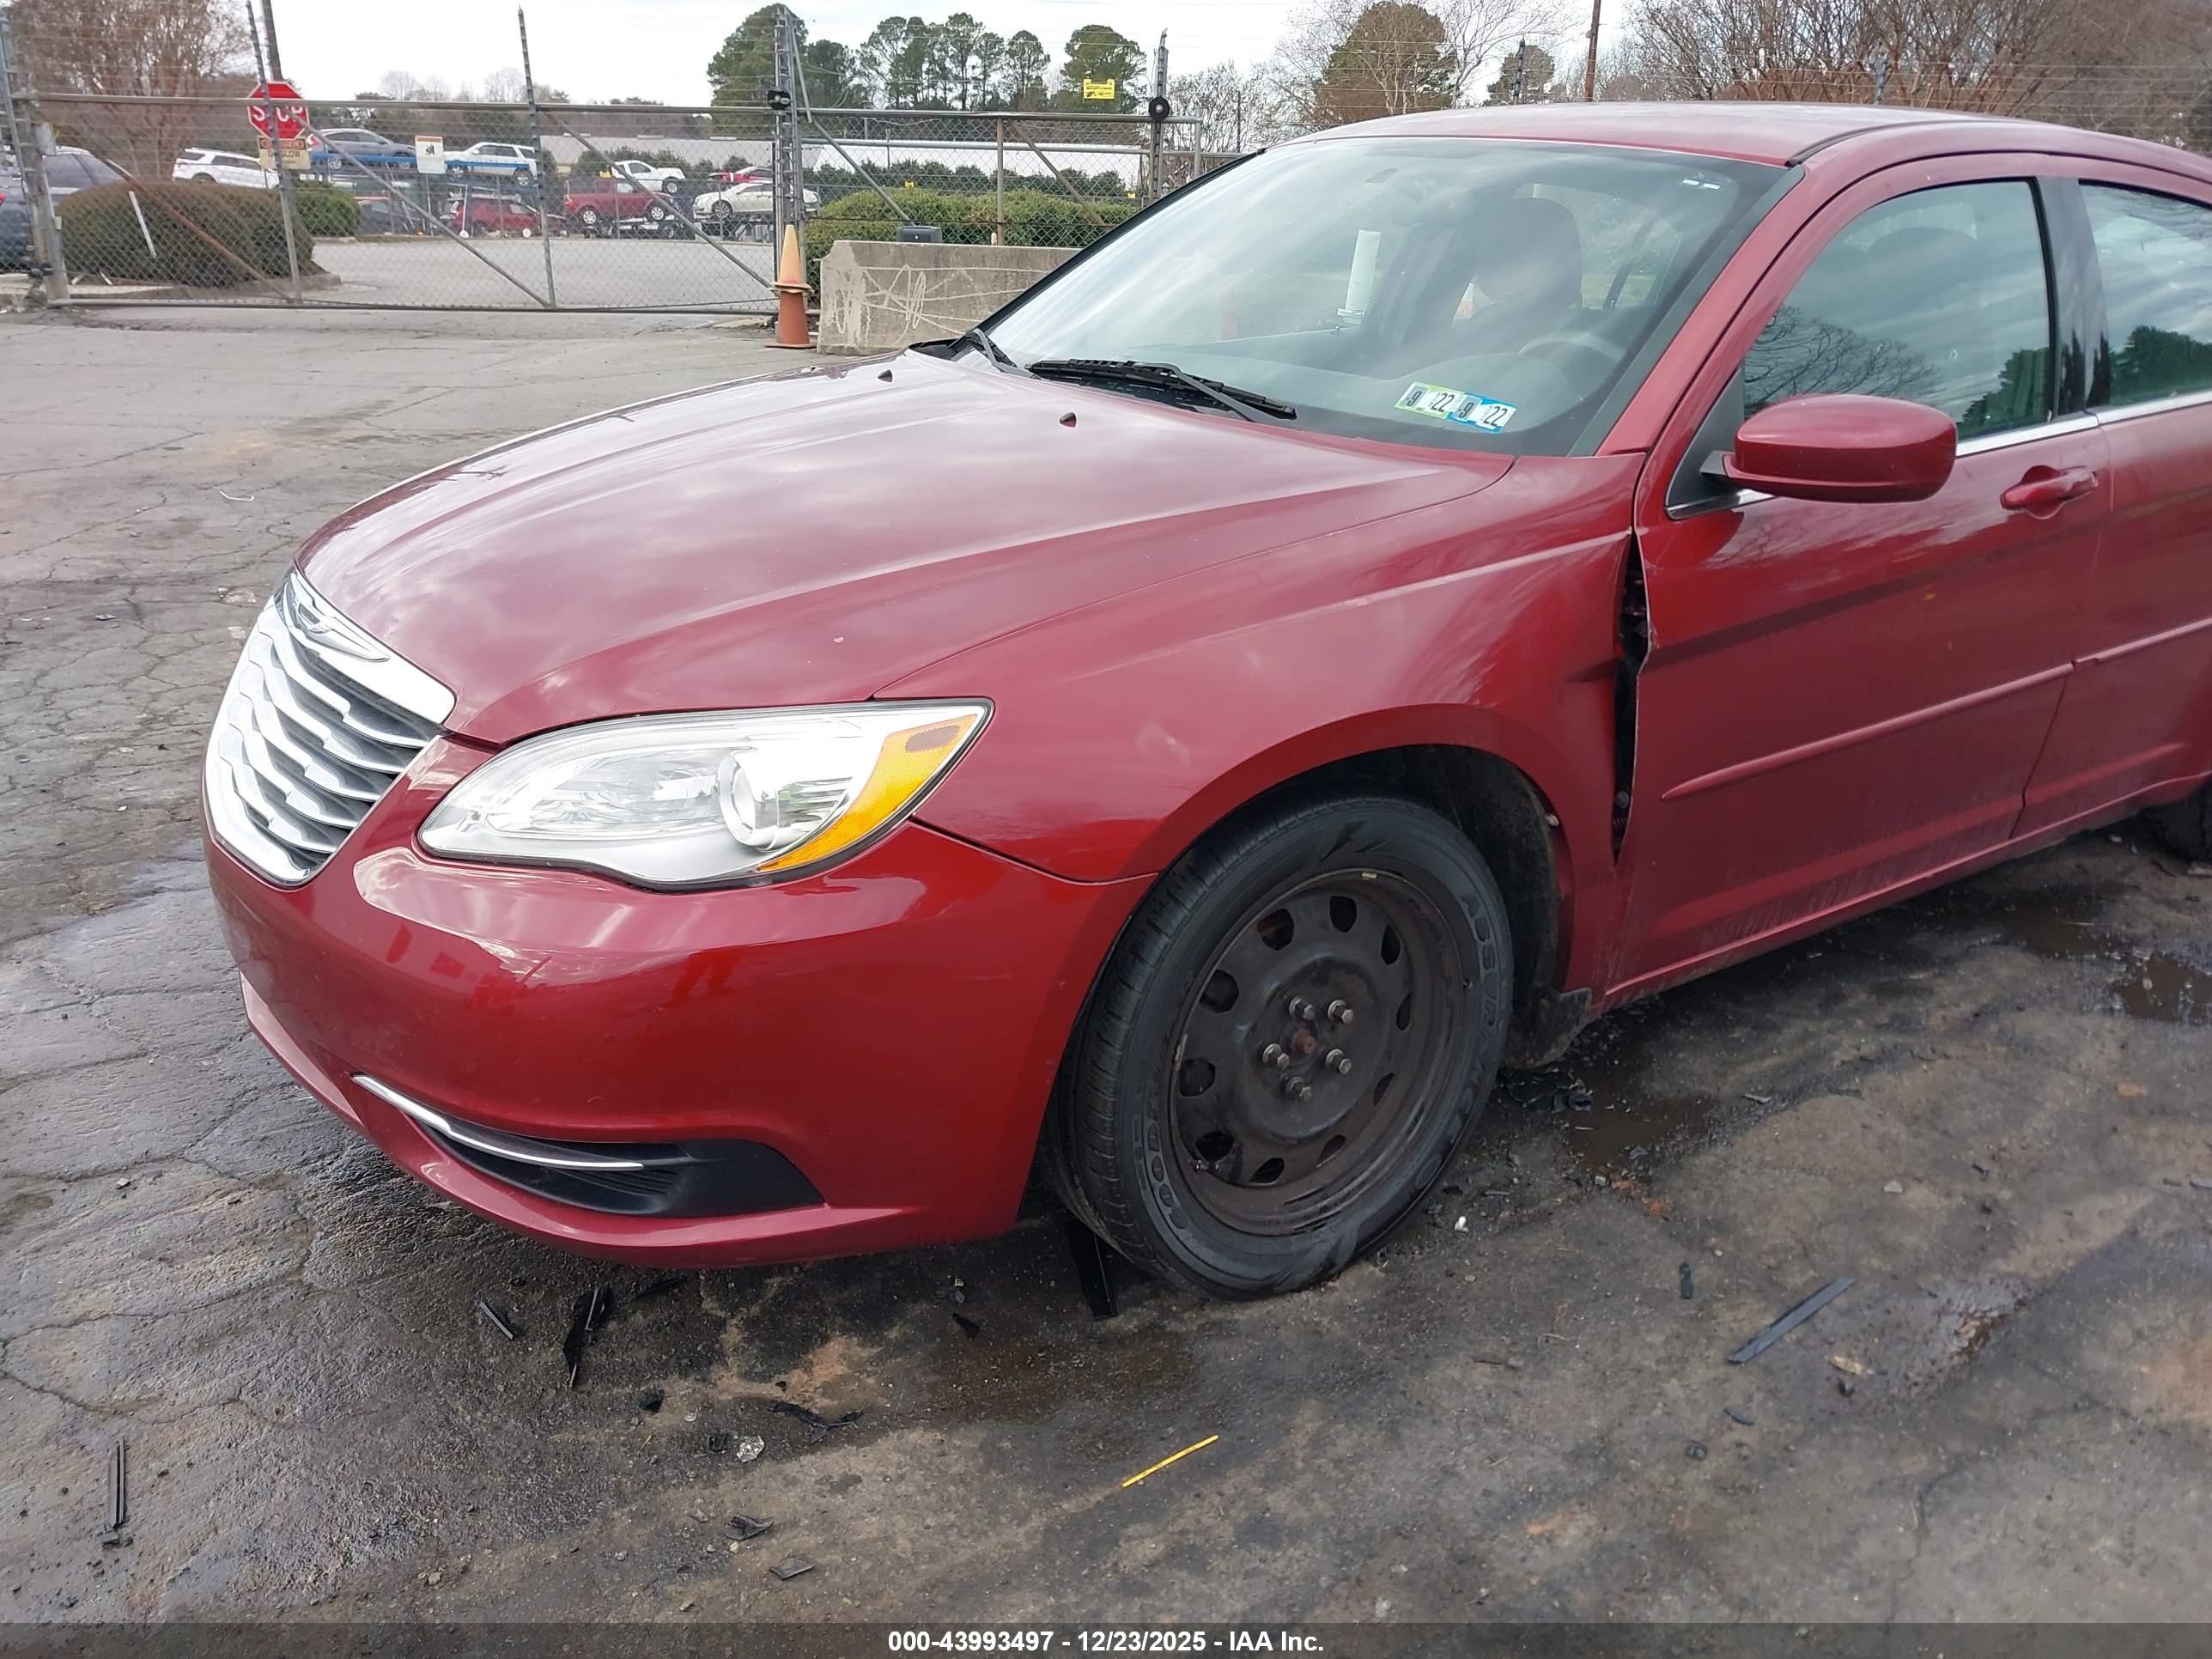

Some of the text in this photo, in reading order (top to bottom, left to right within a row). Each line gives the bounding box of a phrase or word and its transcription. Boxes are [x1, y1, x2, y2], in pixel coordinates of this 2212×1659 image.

[252, 104, 304, 123] SOP
[1430, 392, 1455, 413] 22
[1482, 405, 1508, 428] 22
